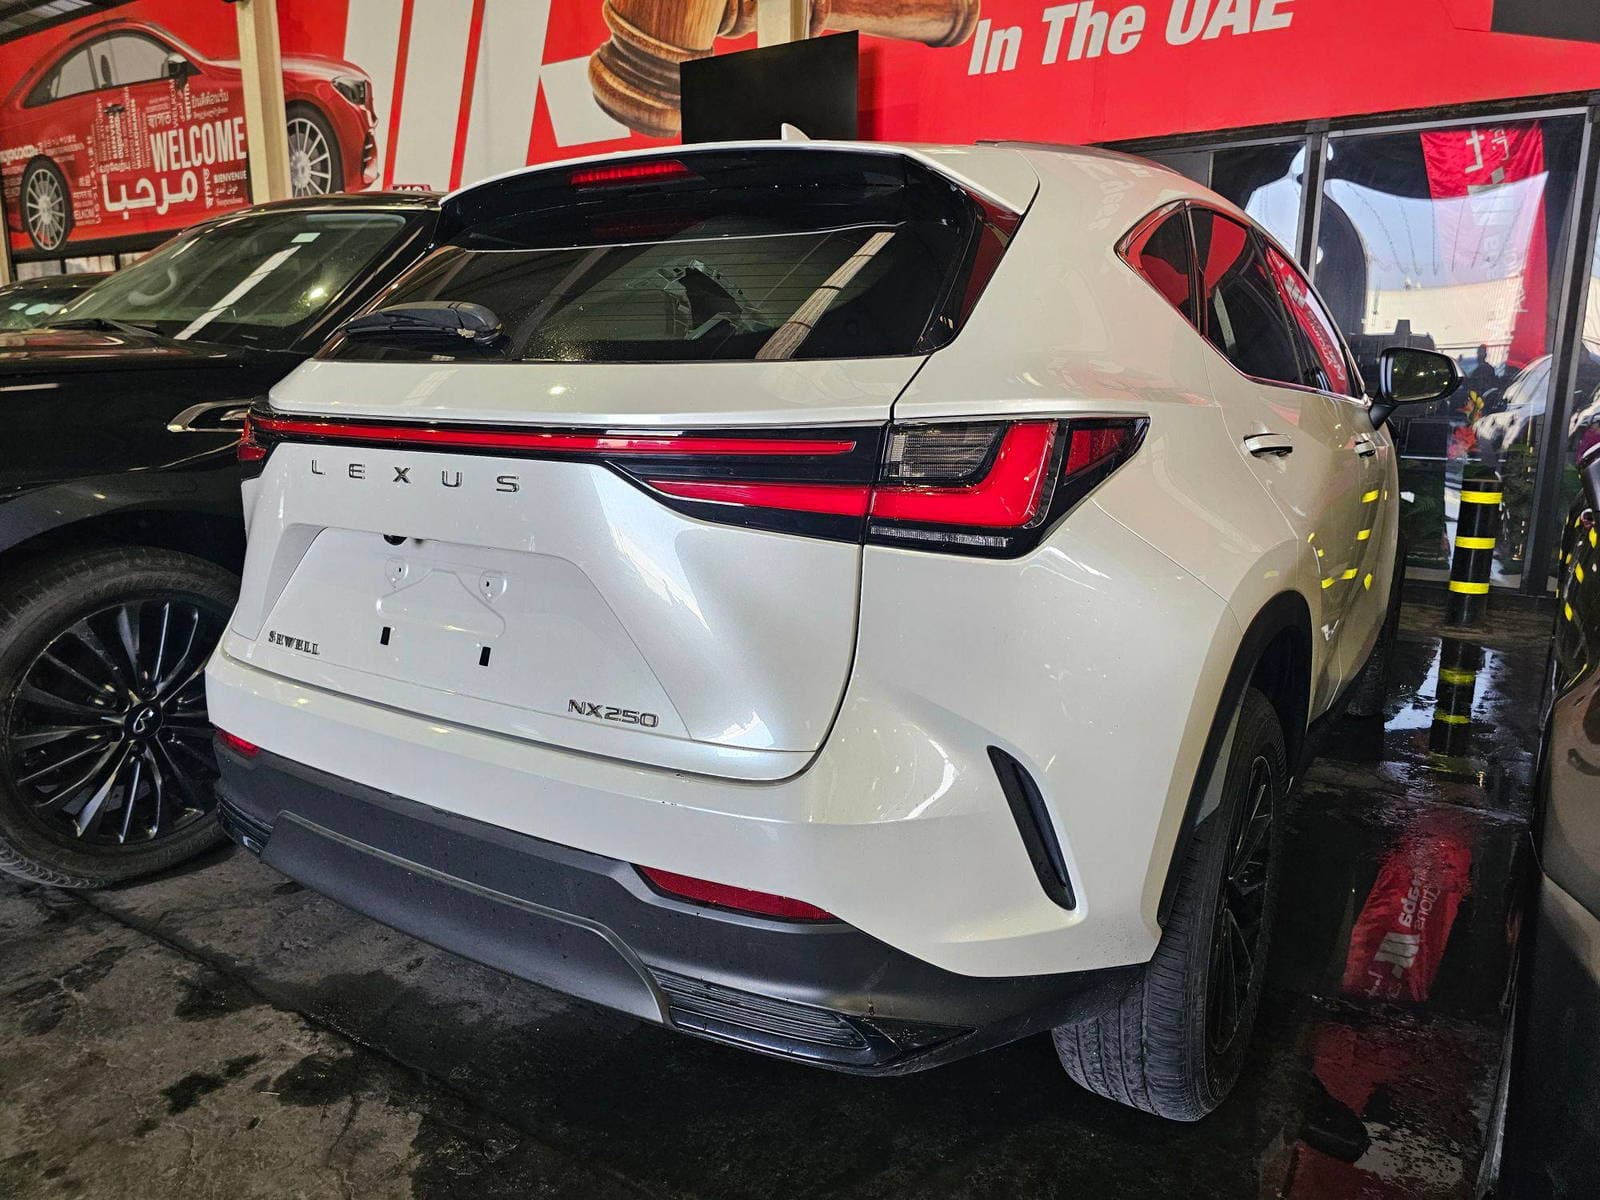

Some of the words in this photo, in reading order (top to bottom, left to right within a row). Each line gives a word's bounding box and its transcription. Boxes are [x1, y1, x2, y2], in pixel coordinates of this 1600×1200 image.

[968, 19, 1022, 75] In
[1041, 1, 1146, 65] The
[1165, 0, 1295, 46] UAE
[149, 116, 247, 173] WELCOME
[102, 169, 198, 220] مرحبا
[311, 459, 520, 493] LEXUS
[268, 630, 321, 655] SEWELL
[567, 699, 659, 728] NX250
